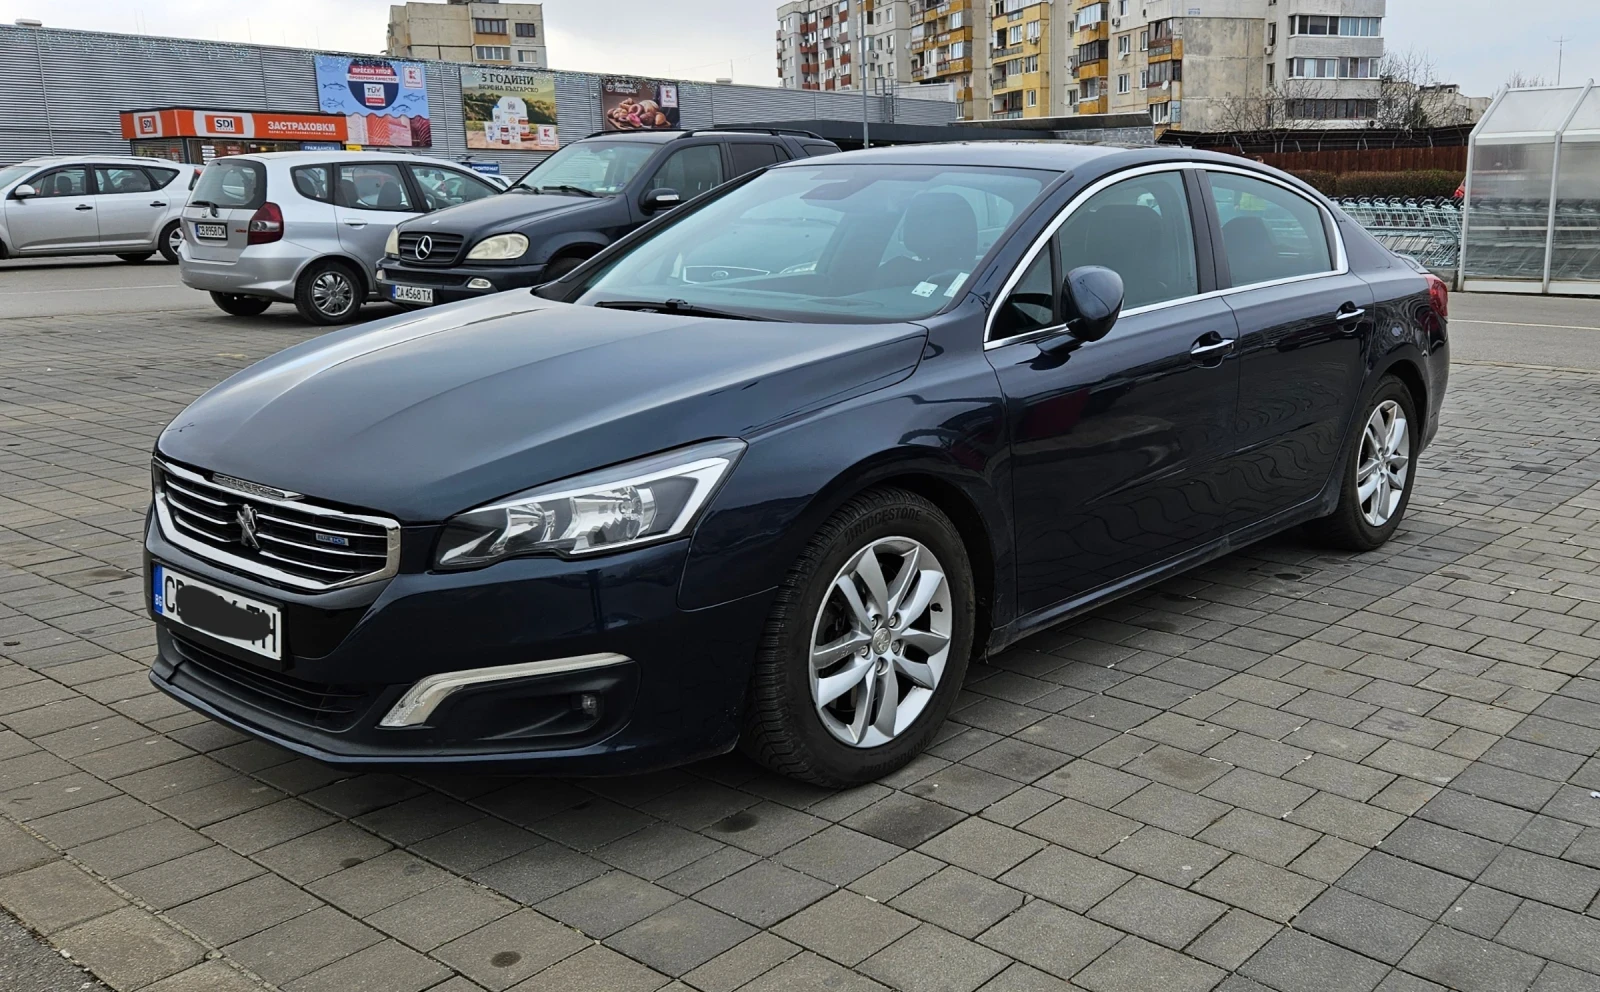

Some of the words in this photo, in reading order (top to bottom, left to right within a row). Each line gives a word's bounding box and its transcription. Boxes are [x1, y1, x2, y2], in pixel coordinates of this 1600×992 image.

[482, 73, 487, 82] 5
[490, 74, 534, 85] ГОДИНИ
[143, 119, 153, 129] SDI
[216, 119, 233, 128] SDI
[267, 121, 336, 132] ЗАСТРАХОВКИ
[396, 287, 404, 299] CA
[405, 287, 421, 300] 4568
[422, 289, 432, 301] TX
[843, 507, 922, 547] BRIDGESTONE
